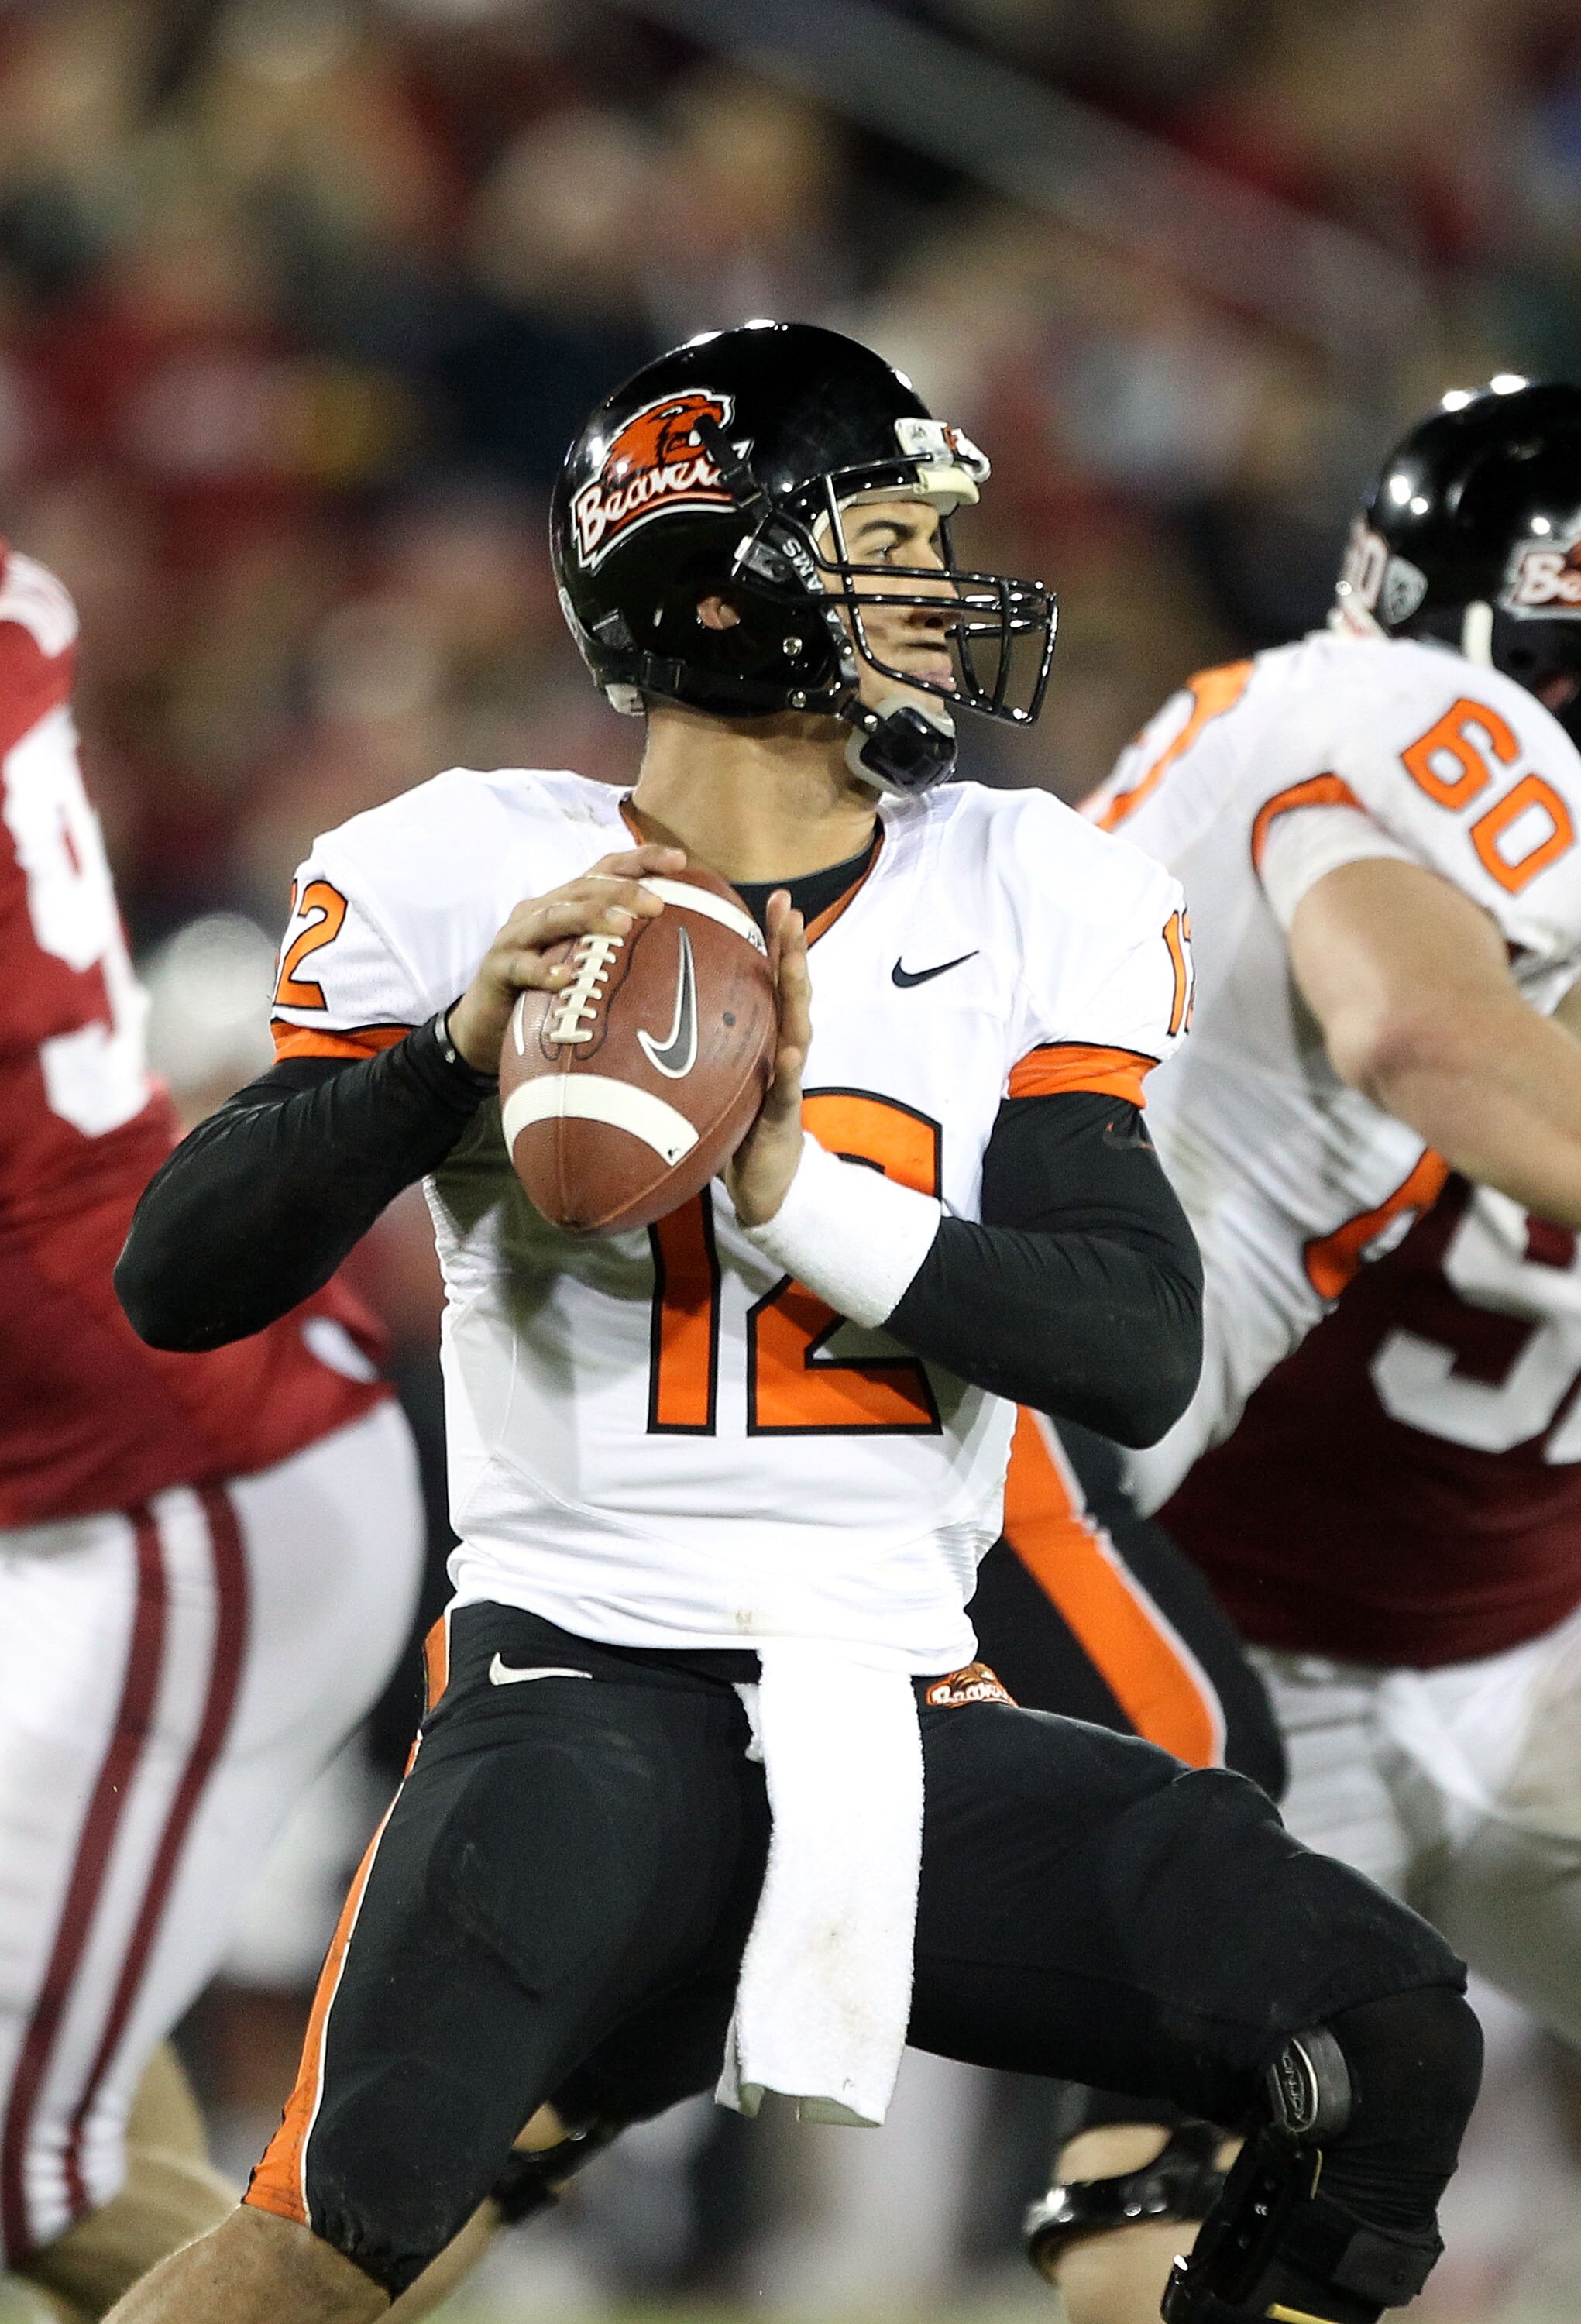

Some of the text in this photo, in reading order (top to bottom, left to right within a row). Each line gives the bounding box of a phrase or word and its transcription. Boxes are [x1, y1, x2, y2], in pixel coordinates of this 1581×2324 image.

[578, 457, 723, 555] Beaver
[1399, 696, 1576, 896] 60
[273, 878, 349, 1012] 2
